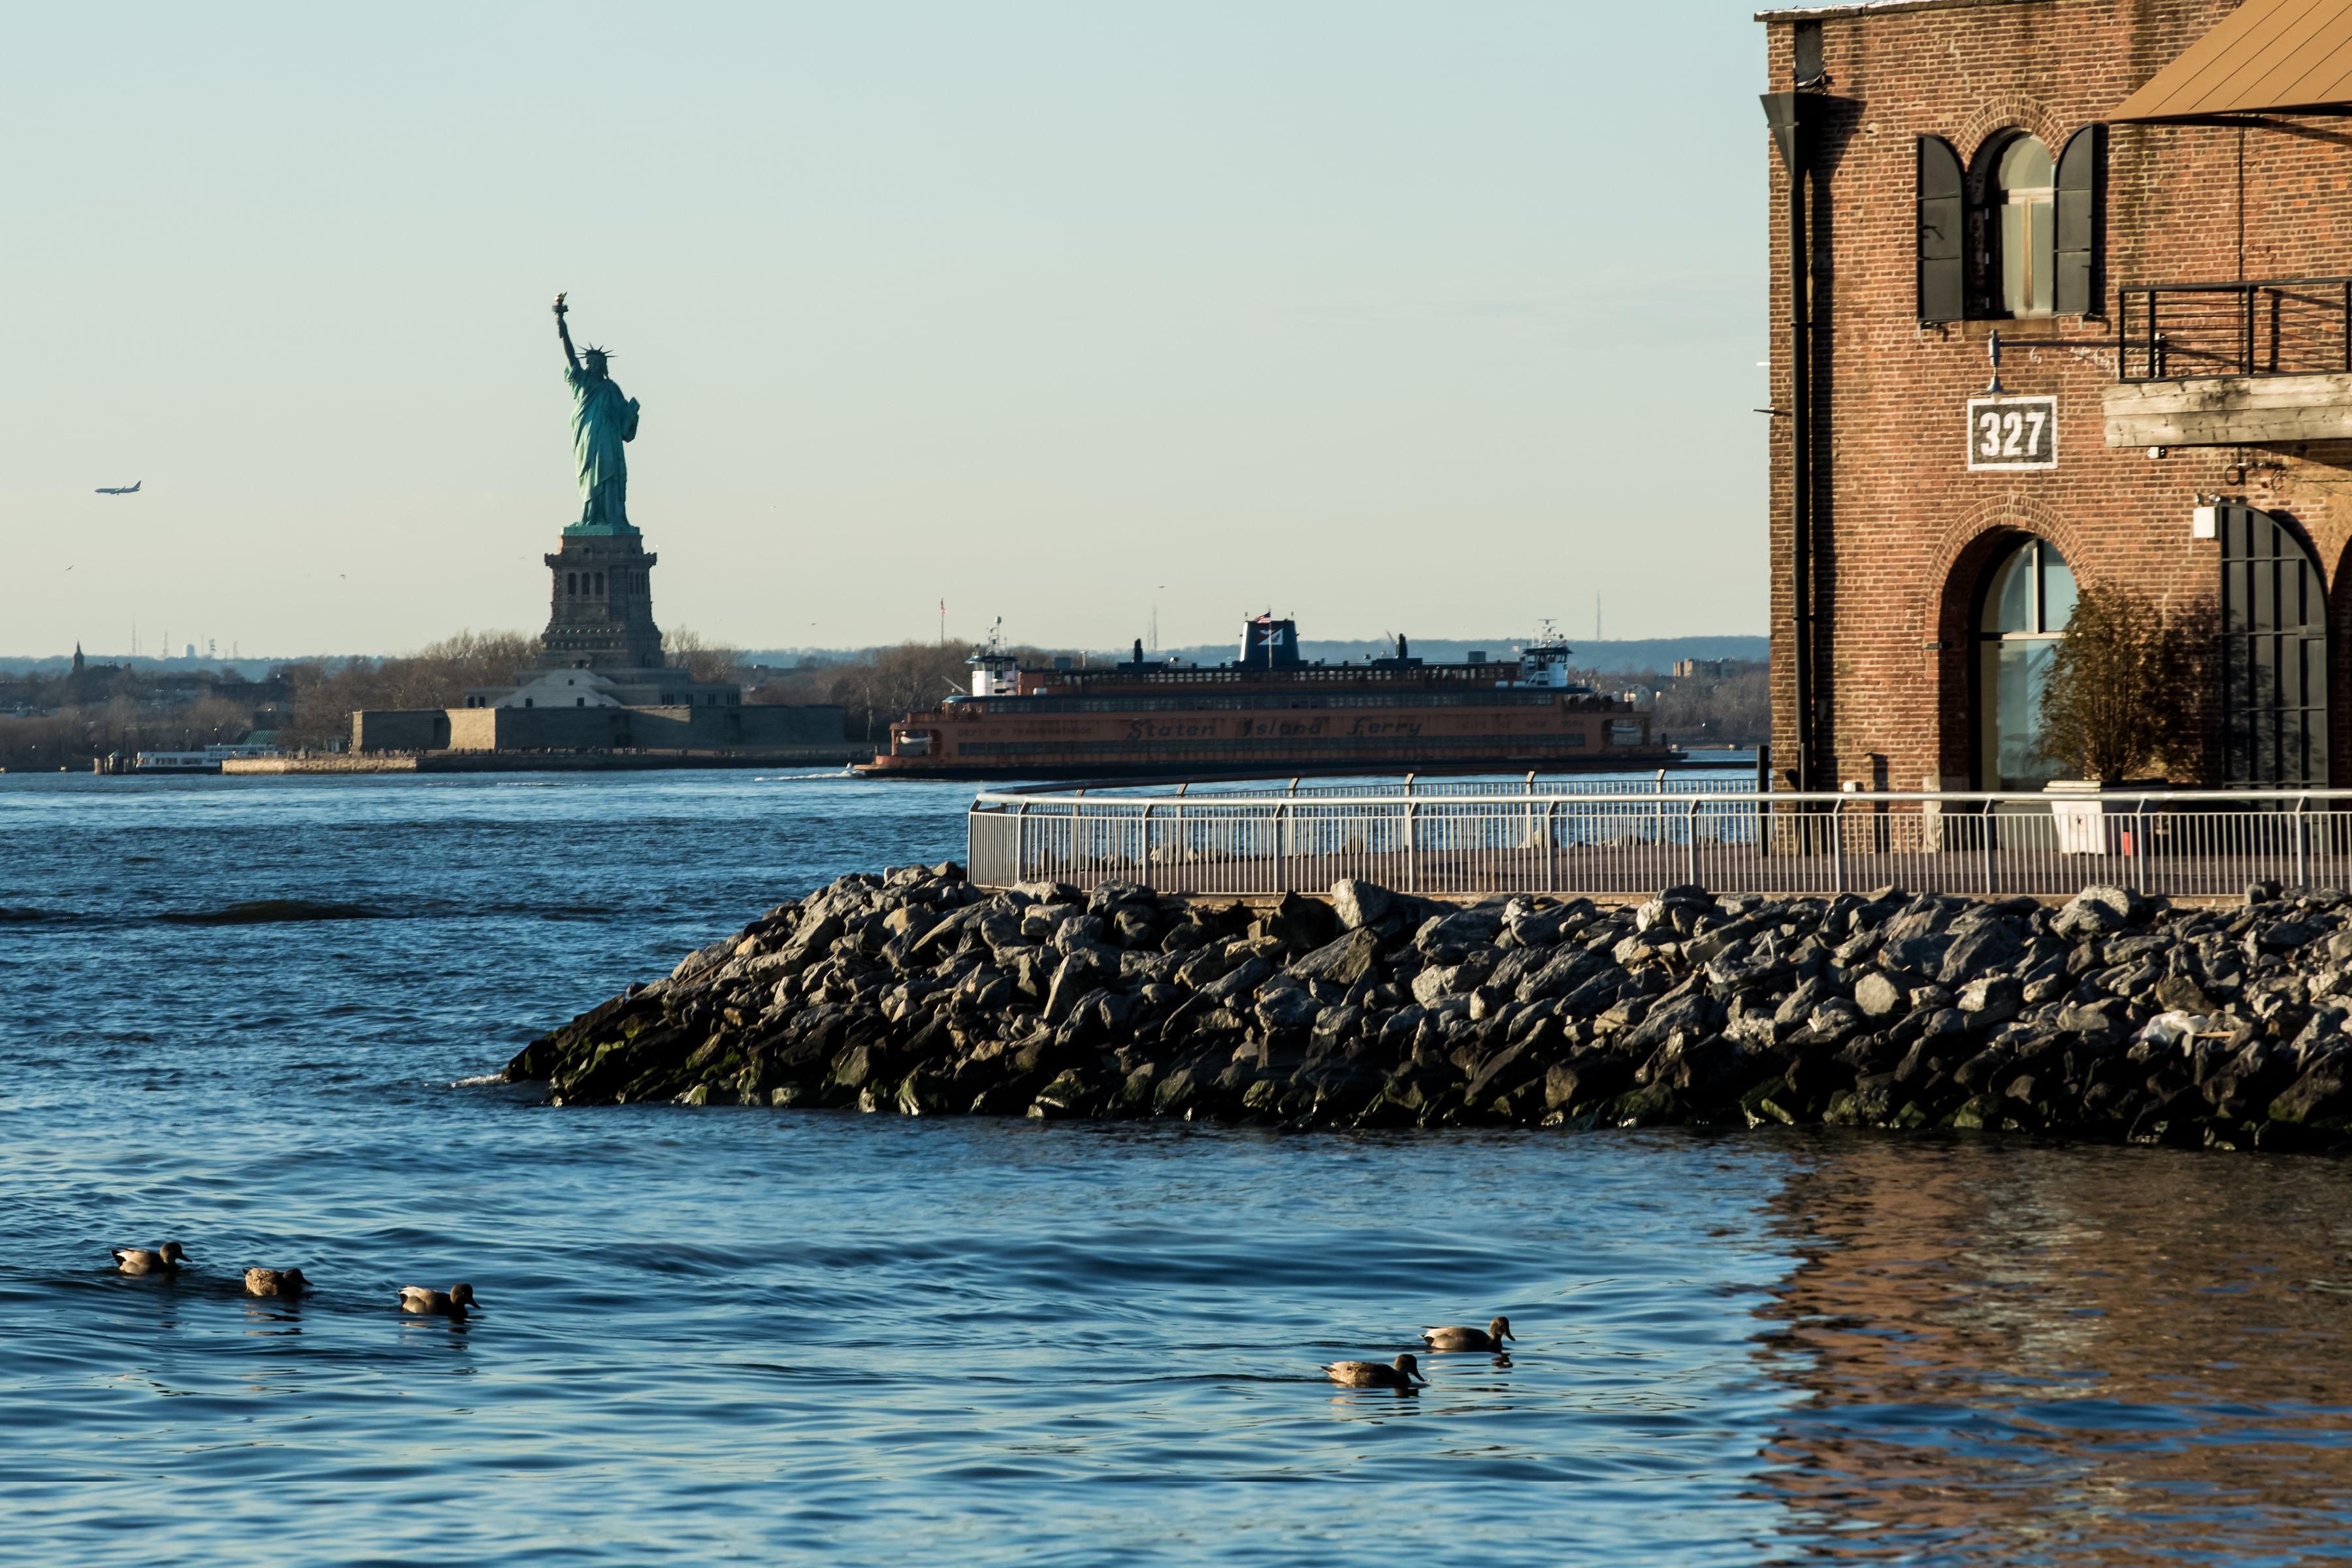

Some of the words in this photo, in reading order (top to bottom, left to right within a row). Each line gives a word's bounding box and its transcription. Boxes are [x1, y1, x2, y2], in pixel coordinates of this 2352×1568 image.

[1980, 412, 2046, 456] 327
[1126, 719, 1215, 740] Staten
[1241, 717, 1323, 737] Island
[1346, 716, 1422, 738] Ferry
